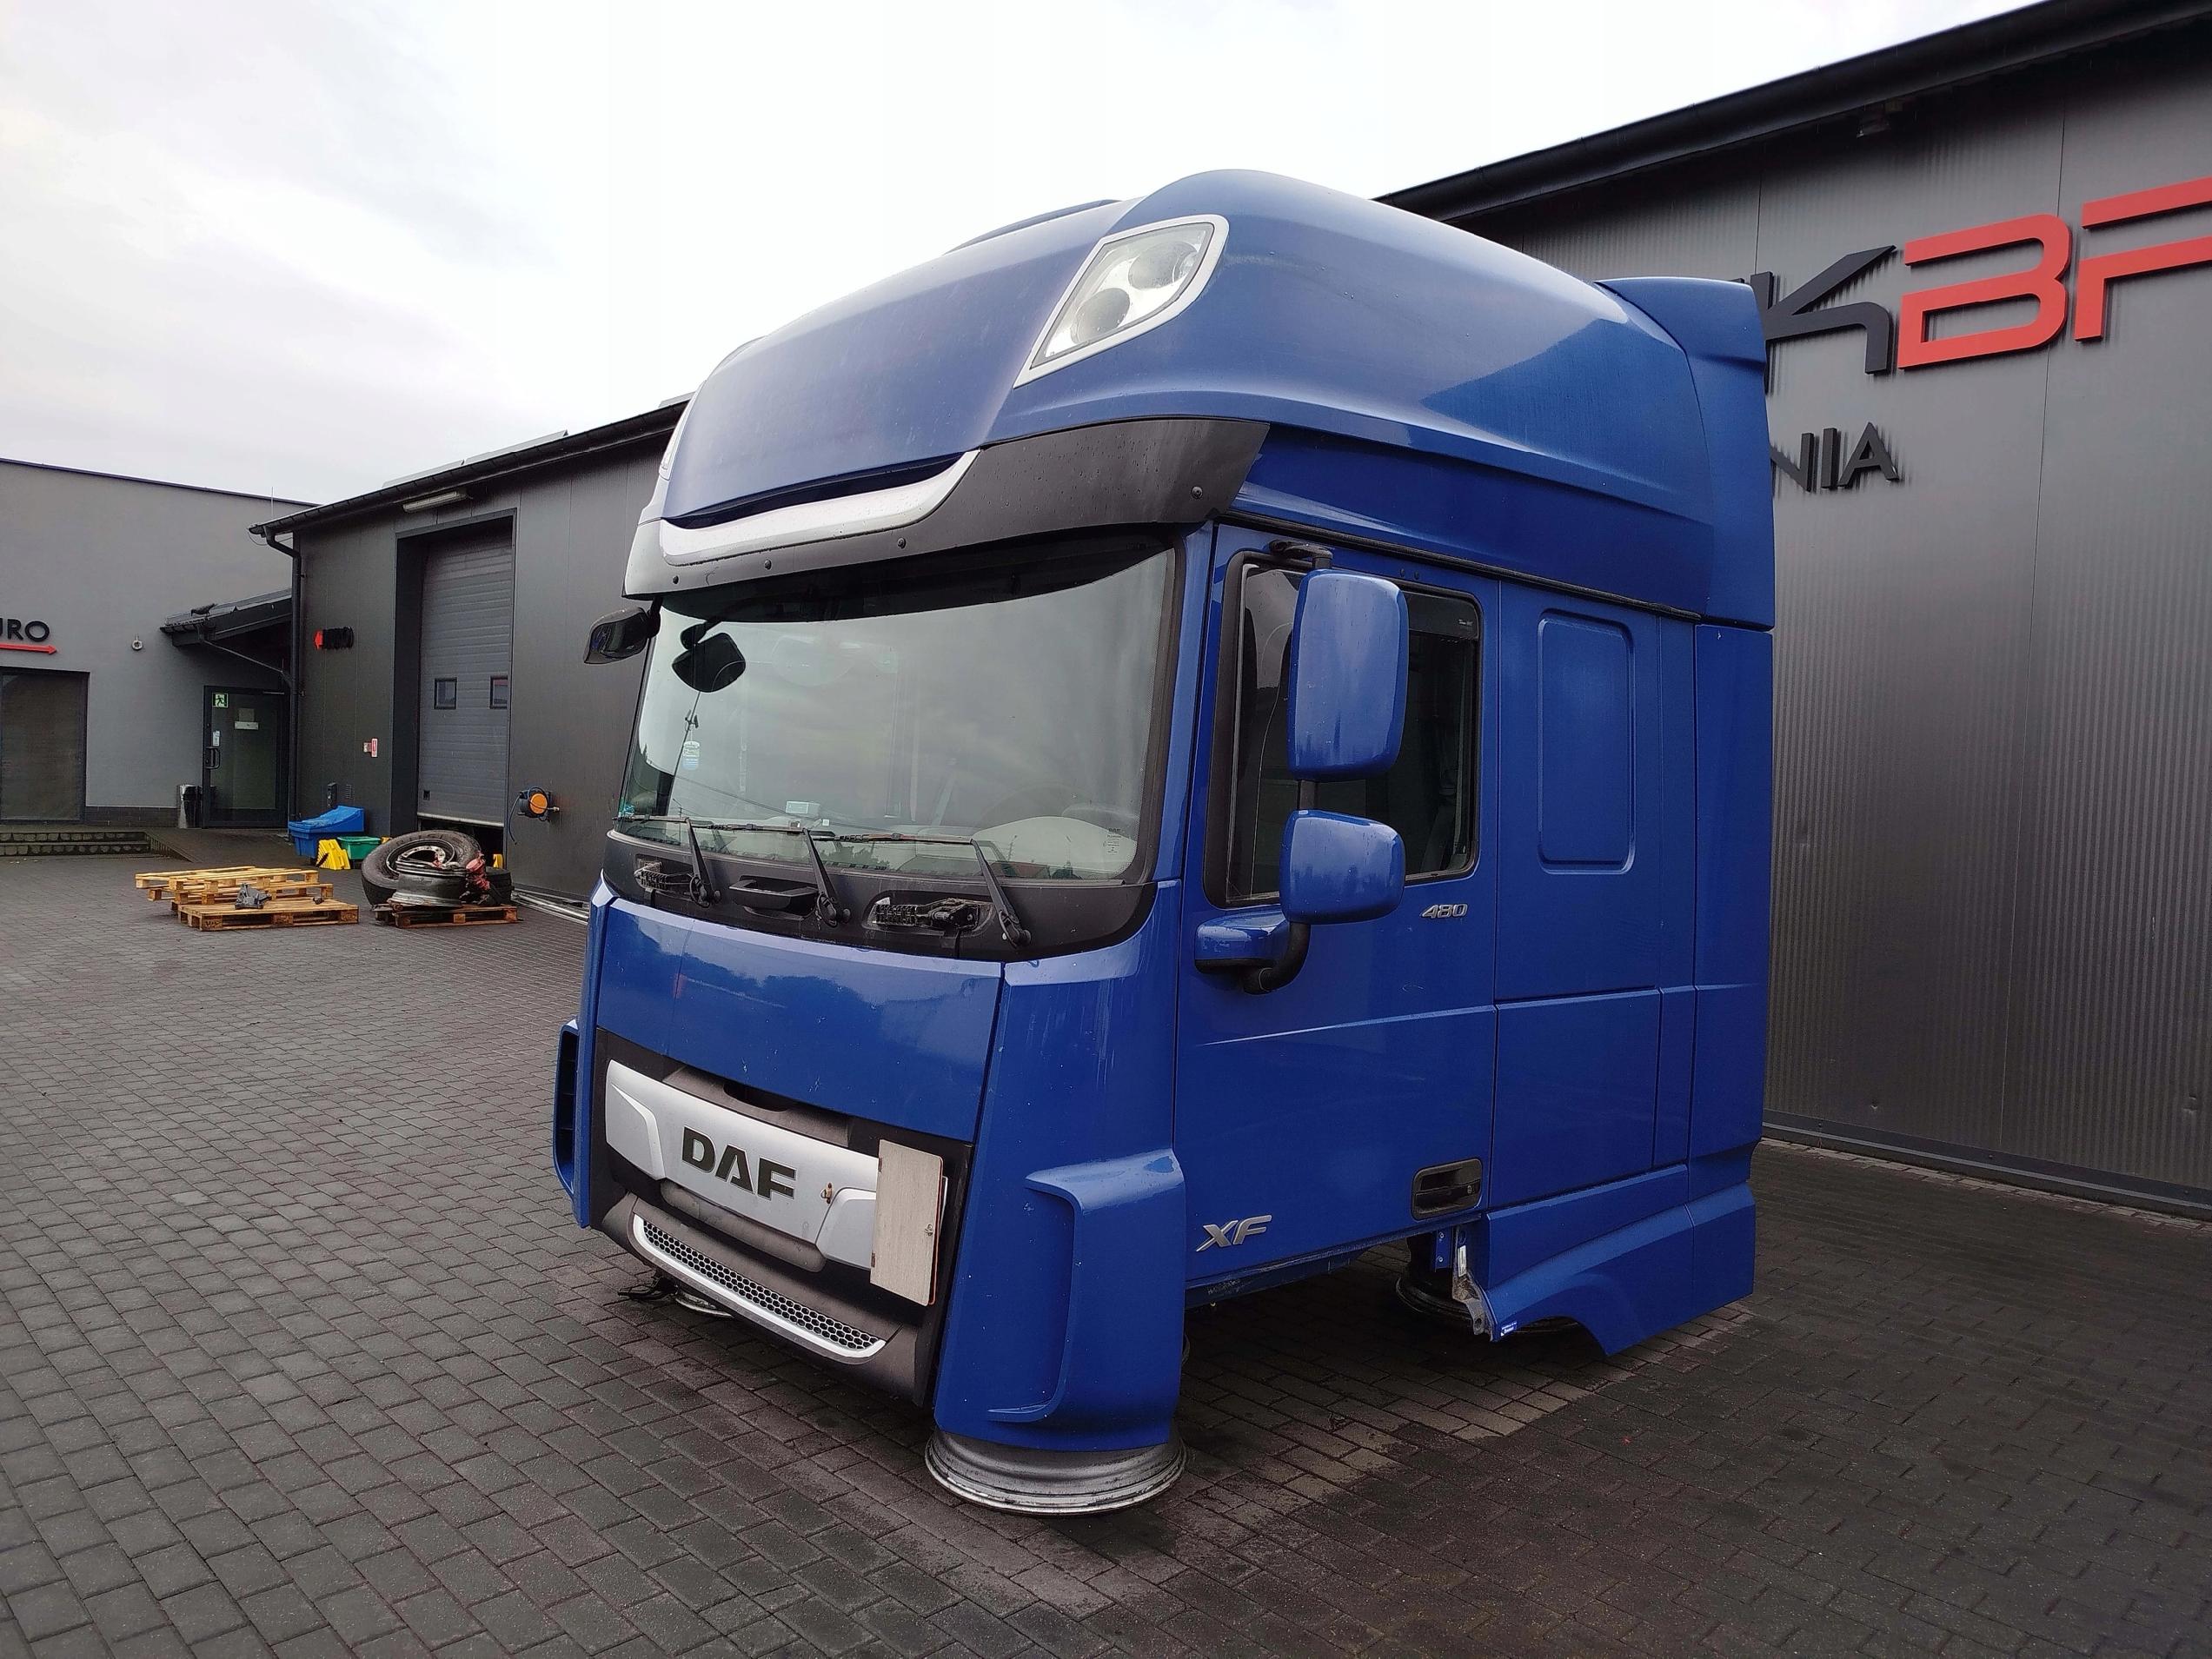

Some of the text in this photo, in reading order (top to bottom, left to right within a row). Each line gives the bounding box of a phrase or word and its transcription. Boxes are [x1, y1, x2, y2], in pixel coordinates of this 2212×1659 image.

[0, 617, 50, 642] RO
[1420, 903, 1468, 919] 480
[681, 1125, 797, 1201] DAF
[1196, 1214, 1272, 1252] XF
